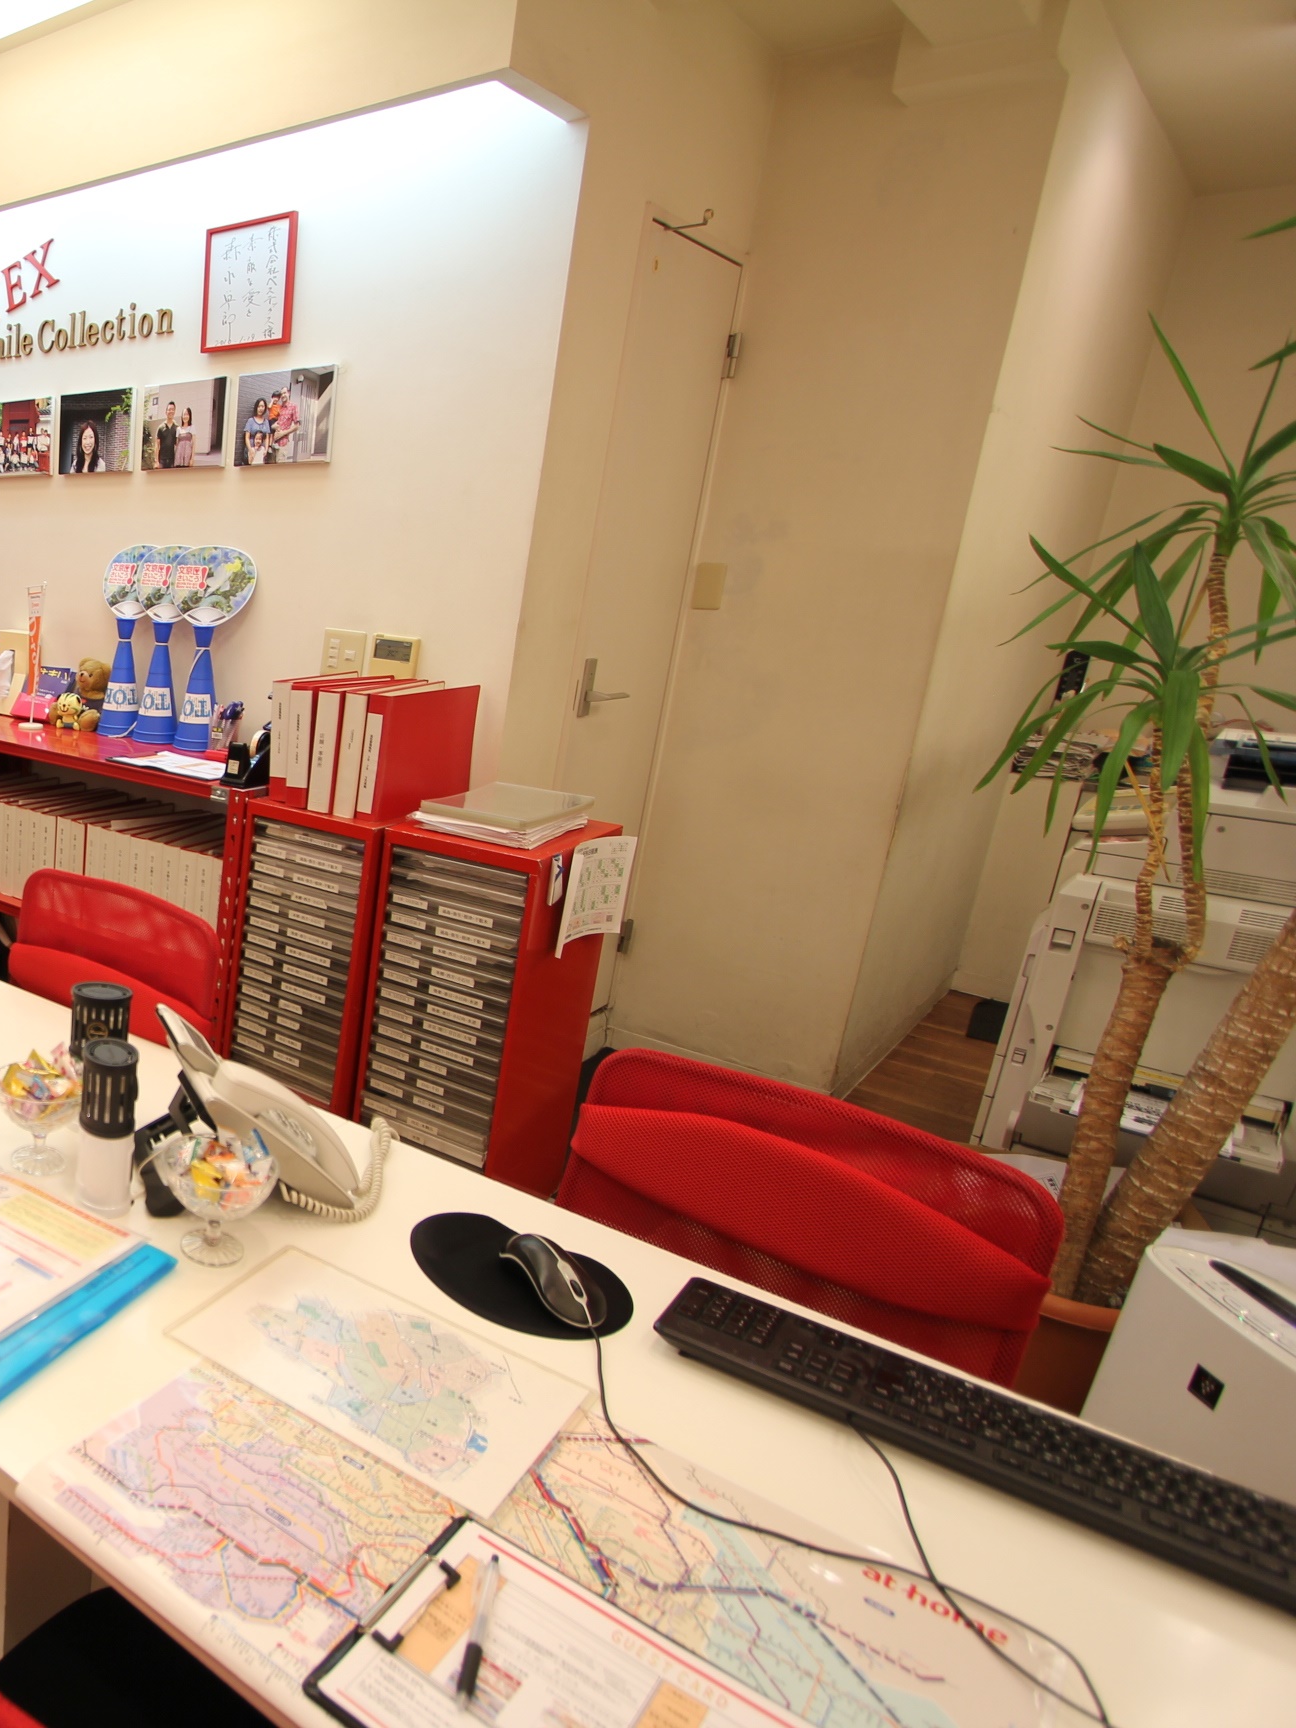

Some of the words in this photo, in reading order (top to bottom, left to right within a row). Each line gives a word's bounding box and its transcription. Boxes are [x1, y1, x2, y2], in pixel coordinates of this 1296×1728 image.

[37, 302, 174, 353] Collection
[862, 1565, 897, 1591] at
[904, 1583, 1008, 1645] home
